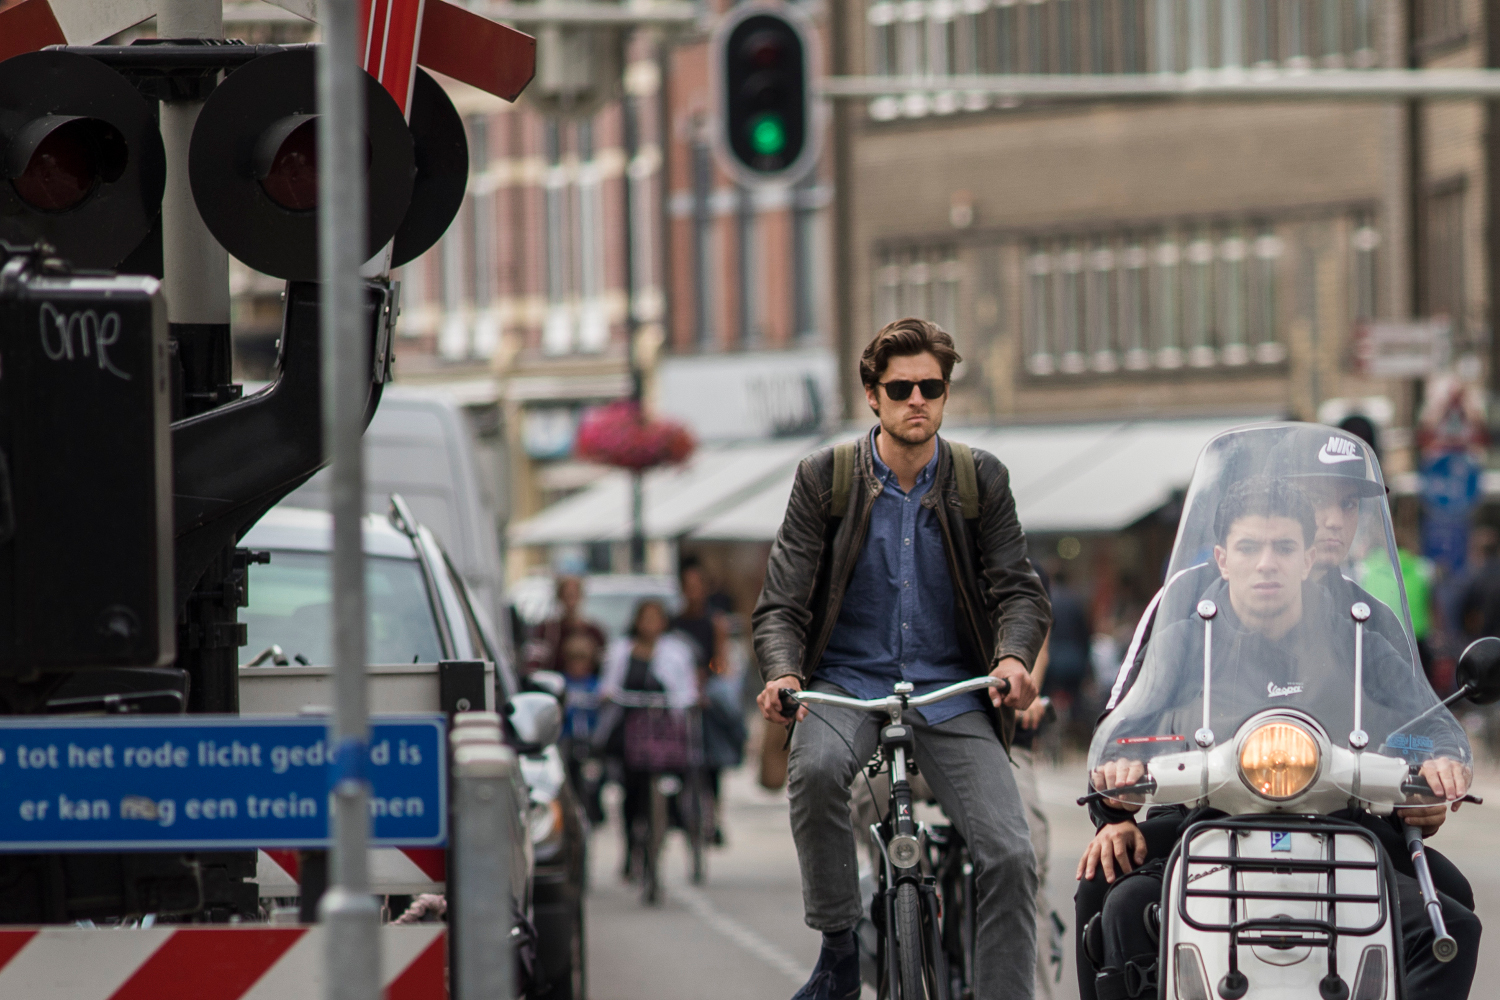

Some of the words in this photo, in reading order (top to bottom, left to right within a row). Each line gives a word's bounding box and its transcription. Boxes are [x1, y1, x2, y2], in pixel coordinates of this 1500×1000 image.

[1327, 436, 1356, 457] NIKE
[1267, 681, 1302, 697] Vespa
[17, 744, 59, 769] tot
[68, 742, 115, 768] het
[123, 741, 190, 768] rode
[198, 740, 262, 767] licht
[399, 739, 422, 765] is
[19, 800, 48, 821] er
[59, 793, 110, 821] kan
[185, 798, 238, 820] een
[247, 791, 317, 819] trein
